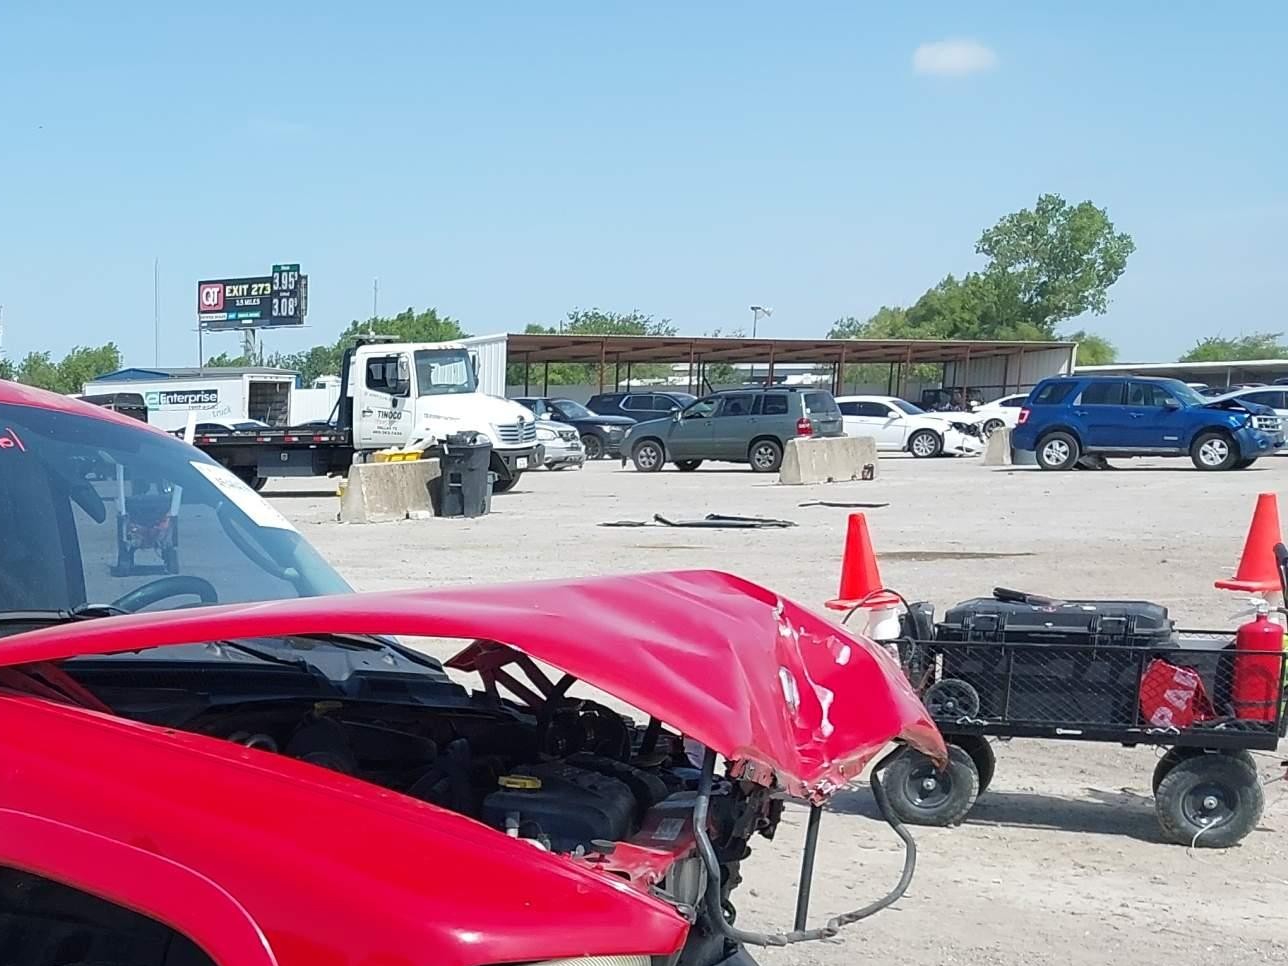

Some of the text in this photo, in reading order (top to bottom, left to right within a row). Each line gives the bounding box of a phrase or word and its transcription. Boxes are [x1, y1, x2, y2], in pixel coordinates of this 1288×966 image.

[202, 287, 221, 307] QT
[225, 285, 249, 297] EXIT
[251, 283, 271, 295] 273
[160, 391, 218, 405] Enterprise
[377, 411, 402, 420] TINOCO
